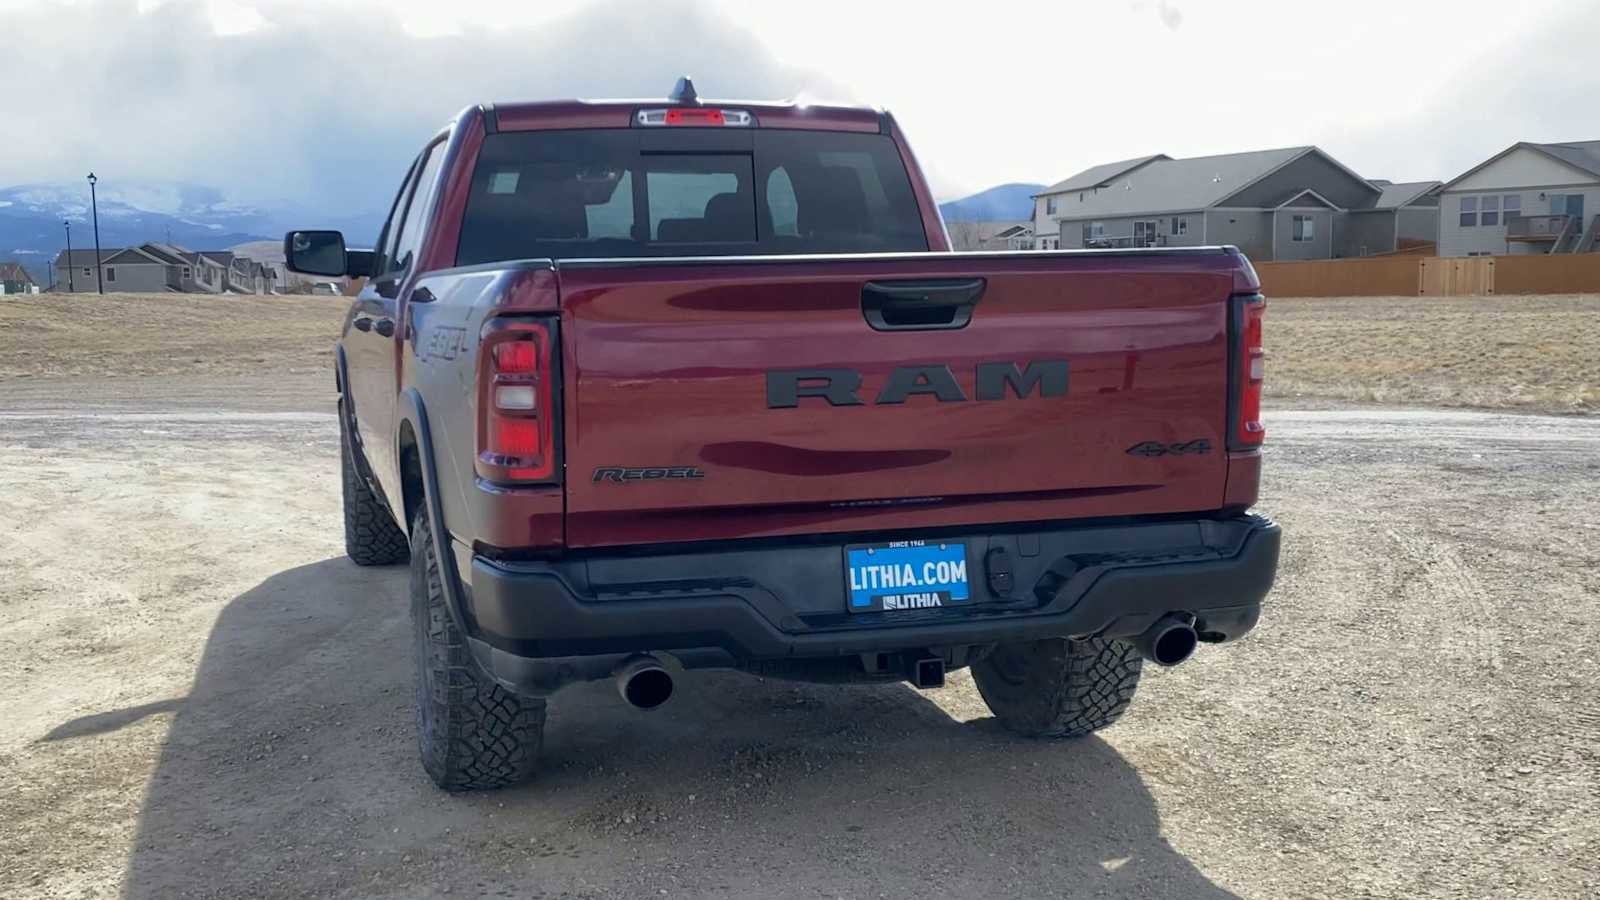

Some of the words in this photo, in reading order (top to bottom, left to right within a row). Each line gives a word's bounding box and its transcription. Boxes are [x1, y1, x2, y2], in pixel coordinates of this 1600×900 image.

[766, 360, 1069, 409] RAM
[591, 466, 705, 482] REBEL
[889, 541, 909, 549] SINCE
[850, 560, 967, 590] LITHIA.COM
[896, 593, 942, 609] LITHIA
